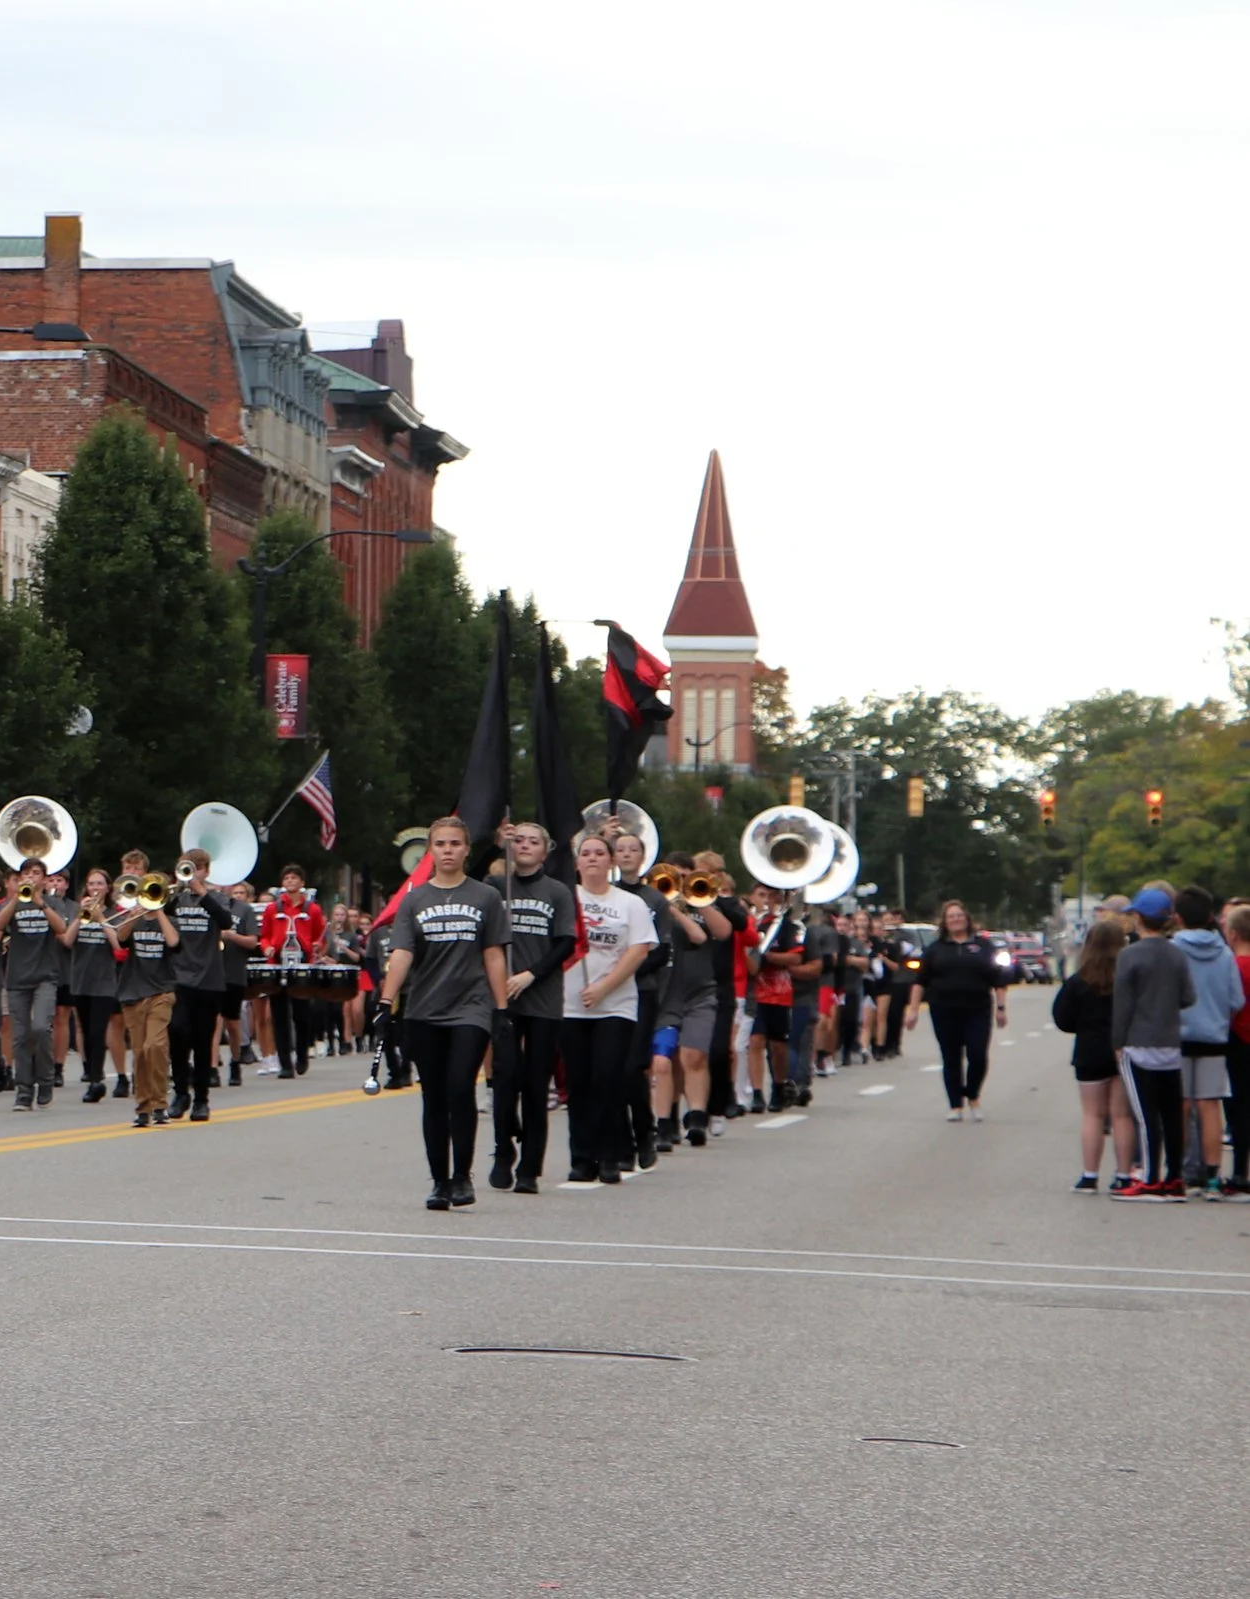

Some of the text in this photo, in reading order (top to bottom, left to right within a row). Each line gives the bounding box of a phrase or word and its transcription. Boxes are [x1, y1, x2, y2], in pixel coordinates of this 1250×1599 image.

[274, 661, 288, 713] Celebrate
[416, 903, 483, 924] MARSHALL
[584, 902, 621, 920] RSHALL
[444, 921, 478, 933] SCHOOL
